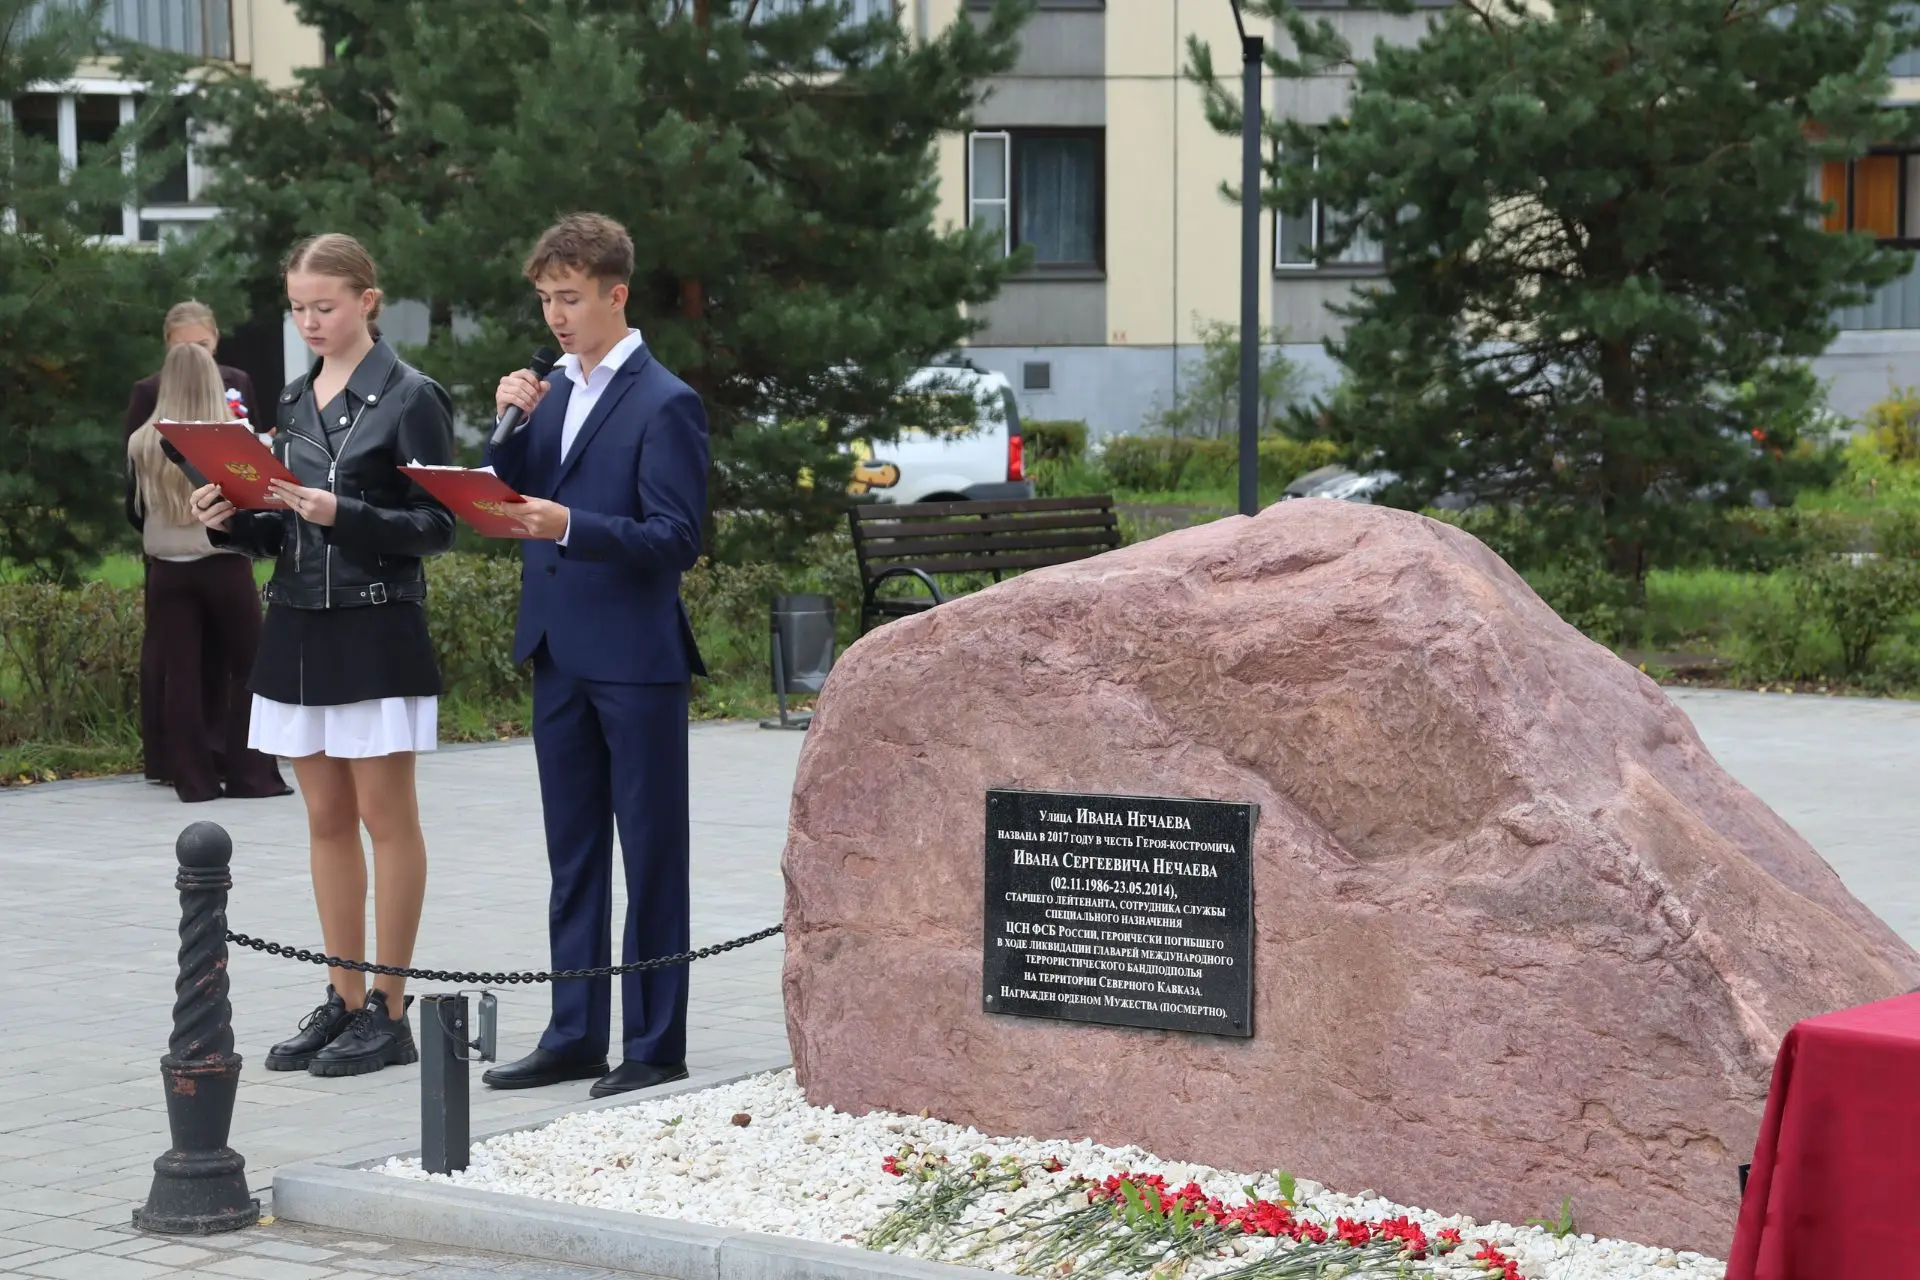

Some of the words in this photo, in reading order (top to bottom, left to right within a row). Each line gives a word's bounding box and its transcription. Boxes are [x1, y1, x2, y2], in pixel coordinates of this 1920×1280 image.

[1040, 810, 1072, 823] УЛИЦА
[1076, 808, 1123, 826] ИВАНА
[1127, 810, 1191, 830] НЕЧАЕВА
[998, 829, 1038, 841] НАЗВАНА
[1040, 832, 1046, 842] В
[1047, 831, 1069, 843] 2017
[1070, 834, 1094, 845] ГОДУ
[1096, 835, 1102, 845] В
[1104, 836, 1133, 847] ЧЕСТЬ
[1136, 836, 1235, 853] ГЕРОЯ-КОСТРОМИЧА
[1013, 849, 1059, 867] ИВАНА
[1062, 852, 1149, 873] СЕРГЕЕВИЧА
[1153, 858, 1218, 878] НЕЧАЕВА
[1050, 876, 1178, 899] (02.11.1986-23.05.2014),
[1005, 892, 1054, 904] СТАРШЕГО
[1055, 895, 1118, 910] ЛЕЙТЕНАНТА,
[1120, 900, 1181, 913] СОТРУДНИКА
[1183, 905, 1226, 917] СЛУЖБЫ
[1045, 909, 1119, 923] СПЕЦИАЛЬНОГО
[1121, 915, 1182, 928] НАЗНАЧЕНИЯ
[1006, 921, 1030, 934] ЦСН
[1032, 924, 1056, 936] ФСБ
[1058, 925, 1099, 940] РОССИИ,
[1101, 931, 1162, 944] ГЕРОИЧЕСКИ
[1164, 936, 1224, 950] ПОГИБШЕГО
[997, 938, 1003, 947] В
[1005, 939, 1027, 949] ХОДЕ
[1029, 940, 1091, 954] ЛИКВИДАЦИИ
[1093, 945, 1139, 958] ГЛАВАРЕЙ
[1141, 949, 1234, 966] МЕЖДУНАРОДНОГО
[1025, 954, 1125, 972] ТЕРРОРИСТИЧЕСКОГО
[1127, 963, 1203, 979] БАНДПОДПОЛЬЯ
[1024, 972, 1037, 981] НА
[1038, 972, 1097, 987] ТЕРРИТОРИИ
[1099, 976, 1154, 992] СЕВЕРНОГО
[1157, 981, 1203, 996] КАВКАЗА.
[1001, 986, 1056, 1001] НАГРАЖДЕН
[1058, 993, 1101, 1005] ОРДЕНОМ
[1104, 995, 1158, 1011] МУЖЕСТВА
[1160, 1002, 1228, 1018] (ПОСМЕРТНО).
